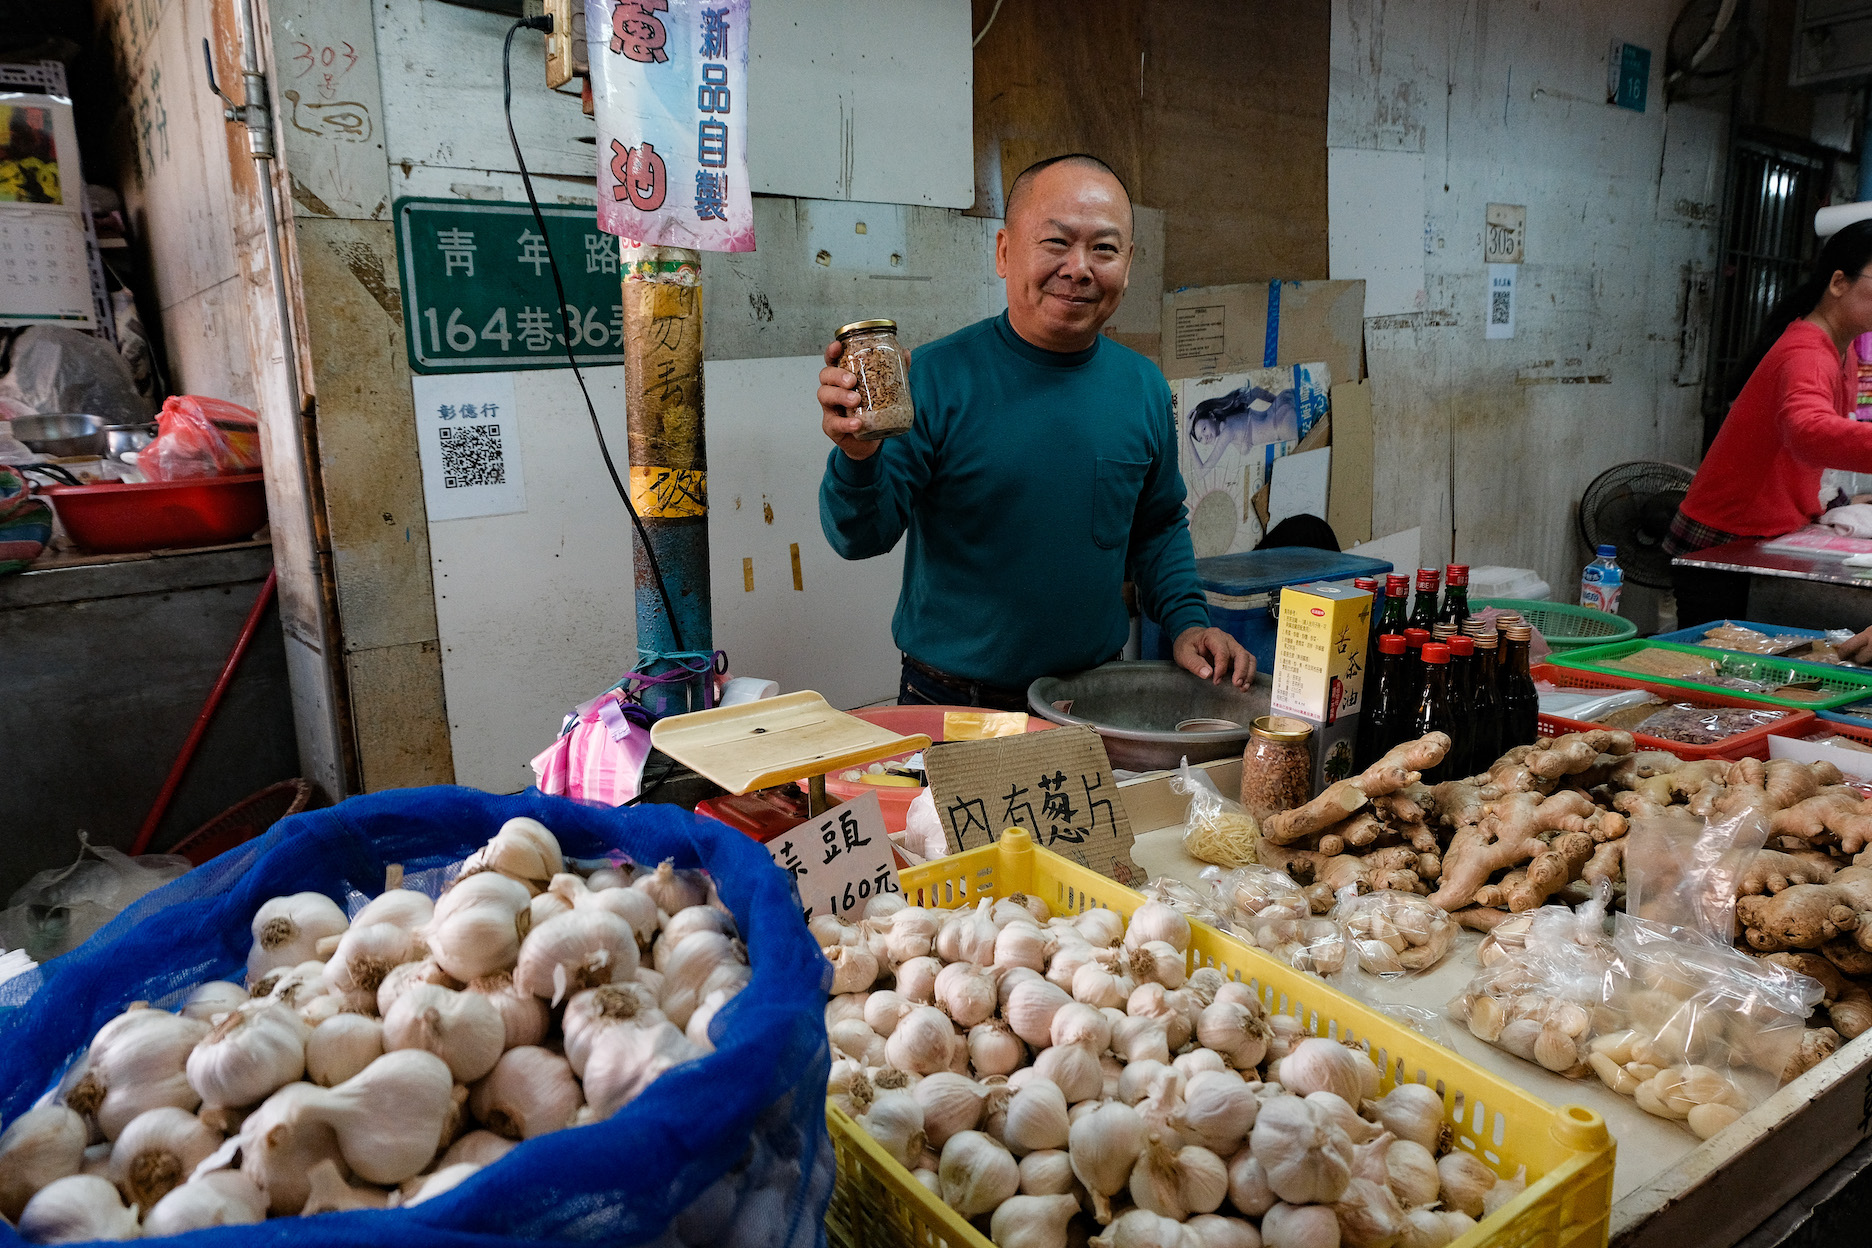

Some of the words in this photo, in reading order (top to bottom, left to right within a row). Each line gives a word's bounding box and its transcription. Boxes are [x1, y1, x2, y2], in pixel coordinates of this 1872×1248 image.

[291, 41, 358, 78] 303
[1627, 77, 1641, 99] 16
[694, 7, 731, 222] 新品自製
[436, 227, 621, 278] 青年路
[1488, 226, 1515, 255] 305
[437, 403, 500, 420] 彰億行
[1334, 625, 1363, 711] 苦茶油
[829, 863, 899, 916] 160元
